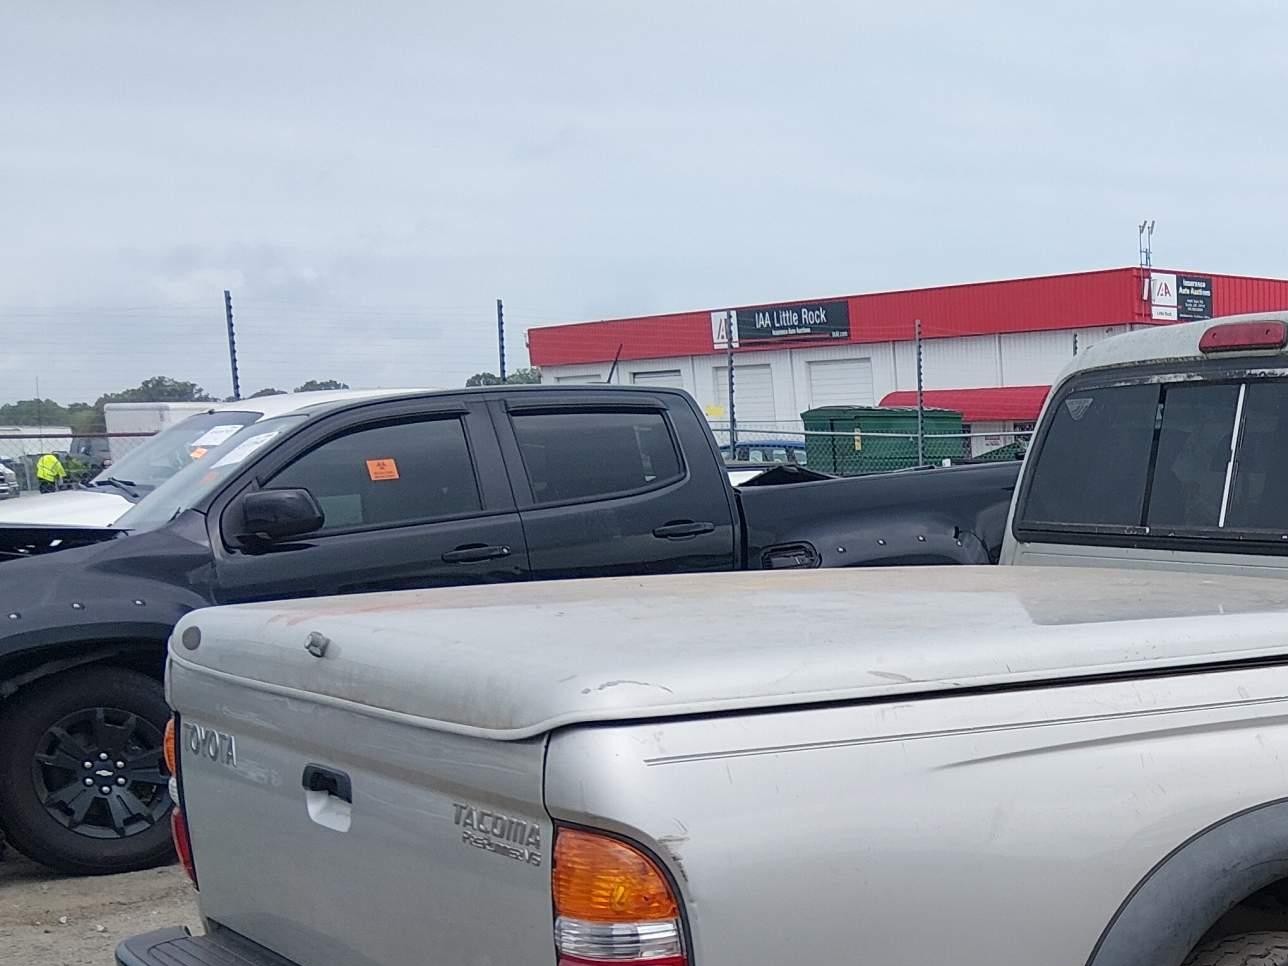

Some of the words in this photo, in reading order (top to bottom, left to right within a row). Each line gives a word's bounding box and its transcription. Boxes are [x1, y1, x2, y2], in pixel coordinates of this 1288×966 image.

[755, 311, 772, 329] IAA
[773, 310, 799, 327] Little
[801, 306, 827, 325] Rock
[183, 721, 238, 768] TOYOTA
[453, 802, 541, 850] TACOMA
